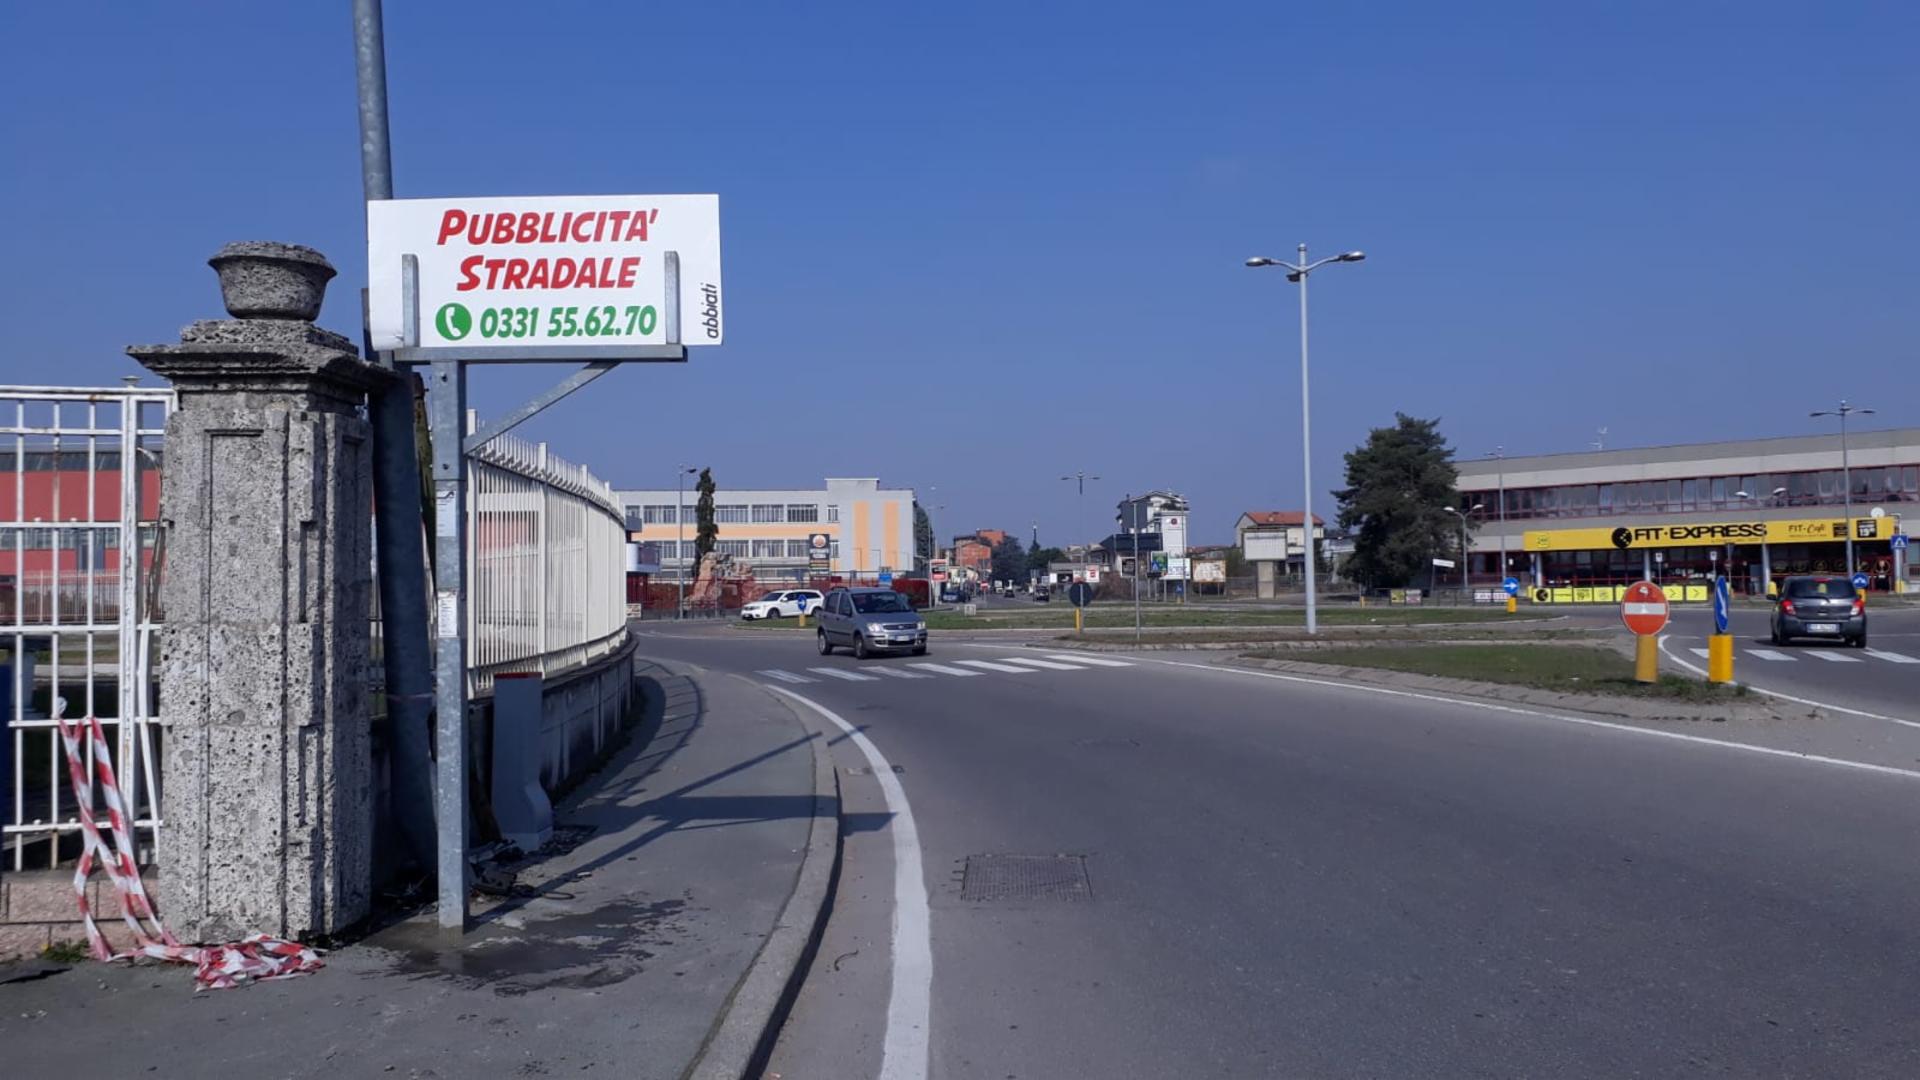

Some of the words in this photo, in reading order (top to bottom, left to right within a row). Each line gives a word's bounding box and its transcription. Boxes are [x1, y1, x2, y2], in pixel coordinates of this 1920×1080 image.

[437, 208, 659, 245] PUBBLICITA'
[456, 255, 641, 291] STRADALE
[480, 306, 539, 338] 0331
[547, 305, 657, 337] 55.62.70
[698, 283, 720, 339] abbiati
